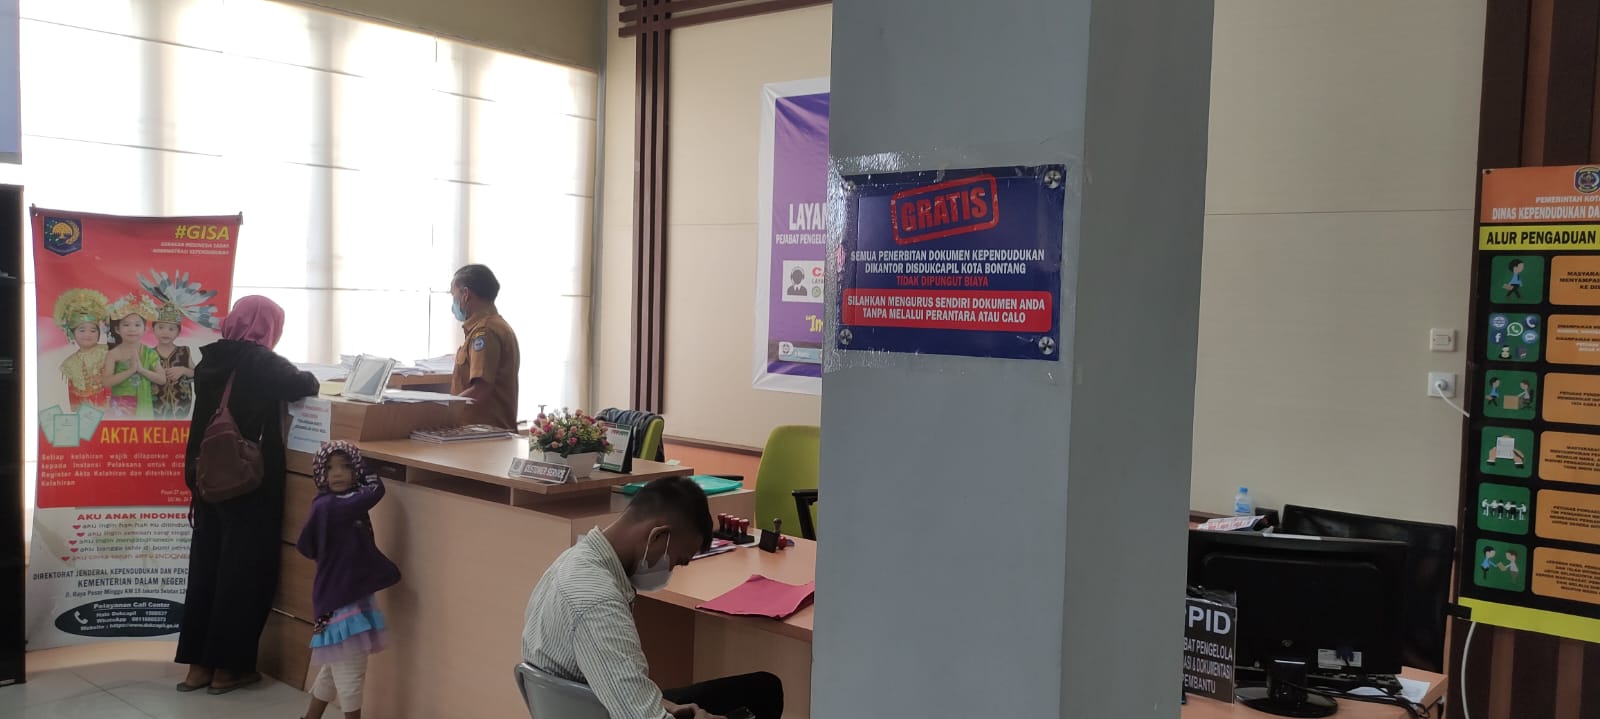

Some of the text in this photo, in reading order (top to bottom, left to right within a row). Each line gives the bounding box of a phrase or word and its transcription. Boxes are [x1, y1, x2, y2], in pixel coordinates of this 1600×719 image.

[1536, 195, 1582, 203] PEMERINTAH
[901, 187, 987, 232] GRATIS
[1492, 207, 1516, 219] DINAS
[1519, 206, 1585, 219] KEPENDUDUKAN
[175, 225, 229, 240] #GISA
[1487, 230, 1596, 245] ALUR PENGADUAN
[851, 249, 1045, 261] SEMUA PENERBITAN DOKUMEN KEPENDUDUKAN
[812, 266, 824, 277] C
[865, 262, 1026, 274] DIKANTOR DISDUKCAPIL KOTA BONTANG
[897, 276, 988, 287] TIDAK DIPUNGUT BIAYA
[848, 296, 1045, 310] SILAHKAN MENGURUS SENDIRI DOKUMEN ANDA
[863, 308, 1026, 323] TANPA MELALUI PERANTARA ATAU CALO
[101, 427, 190, 444] AKTA KELAH
[42, 454, 64, 462] Setiap
[134, 452, 168, 460] dilaporkan
[42, 463, 66, 471] kepada
[42, 471, 71, 479] Register
[33, 571, 73, 580] DIREKTORAT
[76, 569, 108, 577] JENDERAL
[78, 578, 131, 588] KEMENTERIAN
[161, 577, 185, 585] NEGERI
[1189, 605, 1231, 634] PID
[1196, 640, 1233, 660] PENGELOLA
[1197, 659, 1232, 680] DOKUMENTASI
